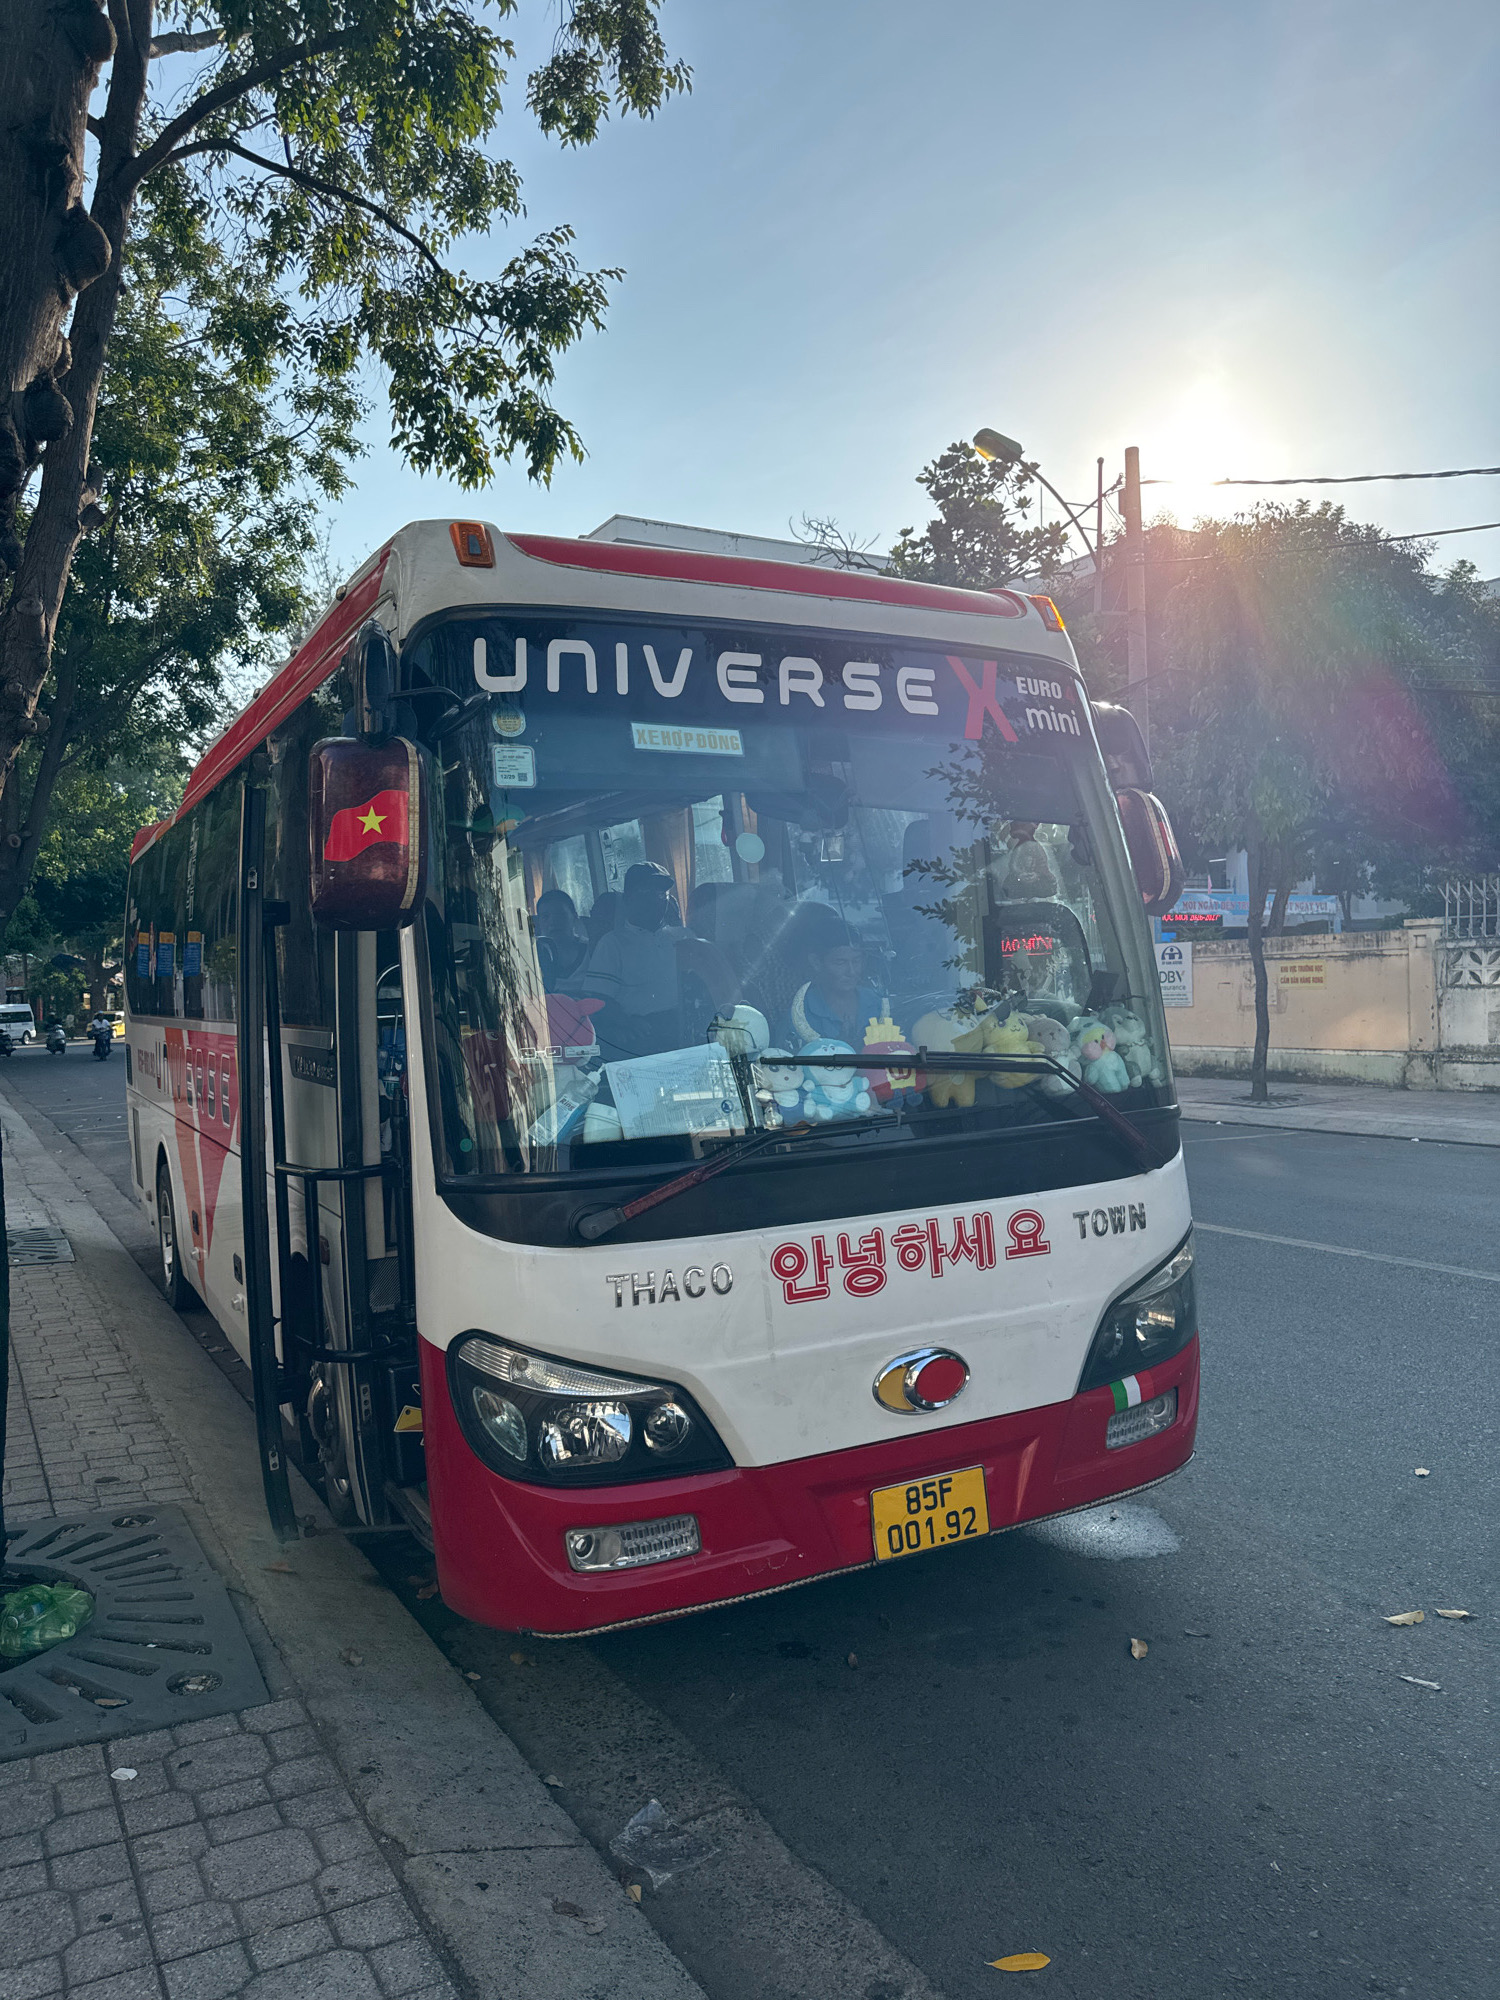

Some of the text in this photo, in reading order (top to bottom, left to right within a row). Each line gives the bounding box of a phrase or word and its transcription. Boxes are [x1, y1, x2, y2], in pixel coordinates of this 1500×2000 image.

[473, 637, 1019, 742] UNIVERSE X
[1016, 676, 1062, 699] EURO
[636, 729, 740, 750] XE HỢP ĐỒNG
[1025, 705, 1081, 736] mini
[1072, 1202, 1147, 1240] TOWN
[769, 1208, 1051, 1305] 안녕하세요
[605, 1262, 734, 1308] THACO
[905, 1477, 953, 1515] 85F
[887, 1506, 978, 1554] 001.92
